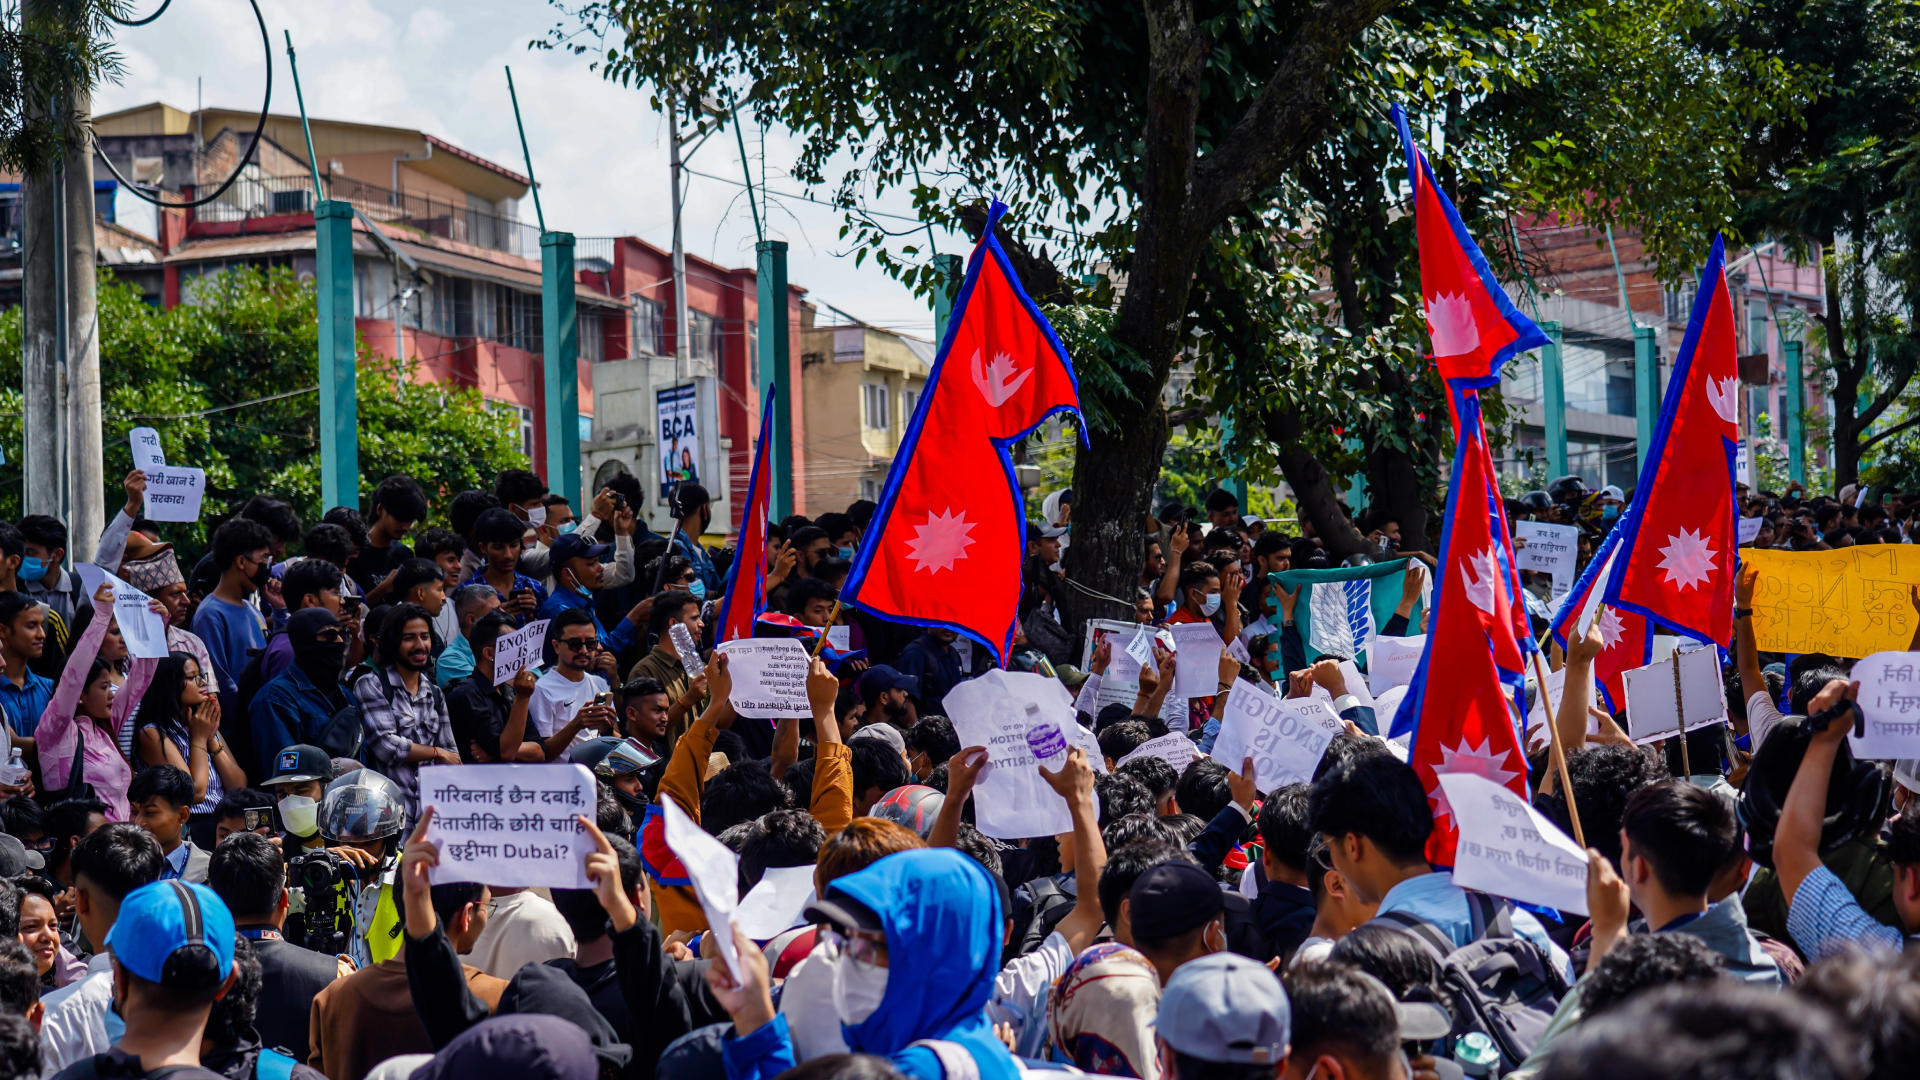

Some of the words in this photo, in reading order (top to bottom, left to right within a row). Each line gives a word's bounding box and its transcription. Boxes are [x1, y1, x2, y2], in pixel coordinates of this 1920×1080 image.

[662, 414, 695, 441] BCA
[166, 475, 187, 487] खान
[189, 474, 196, 487] दे
[150, 493, 185, 505] सरकार!
[1537, 530, 1547, 538] जय
[1550, 528, 1560, 539] देश
[498, 622, 547, 653] ENOUGH
[517, 643, 528, 658] IS
[496, 647, 542, 679] ENOUGH
[741, 700, 756, 708] यहा
[757, 700, 792, 711] सूचीकरण
[434, 784, 504, 806] गरिबलाई
[509, 785, 536, 804] छैन
[541, 785, 586, 808] दबाई,
[432, 811, 504, 832] नेताजीकि
[510, 812, 545, 832] छोरी
[448, 840, 498, 861] छुट्टीमा
[504, 844, 569, 860] Dubai?
